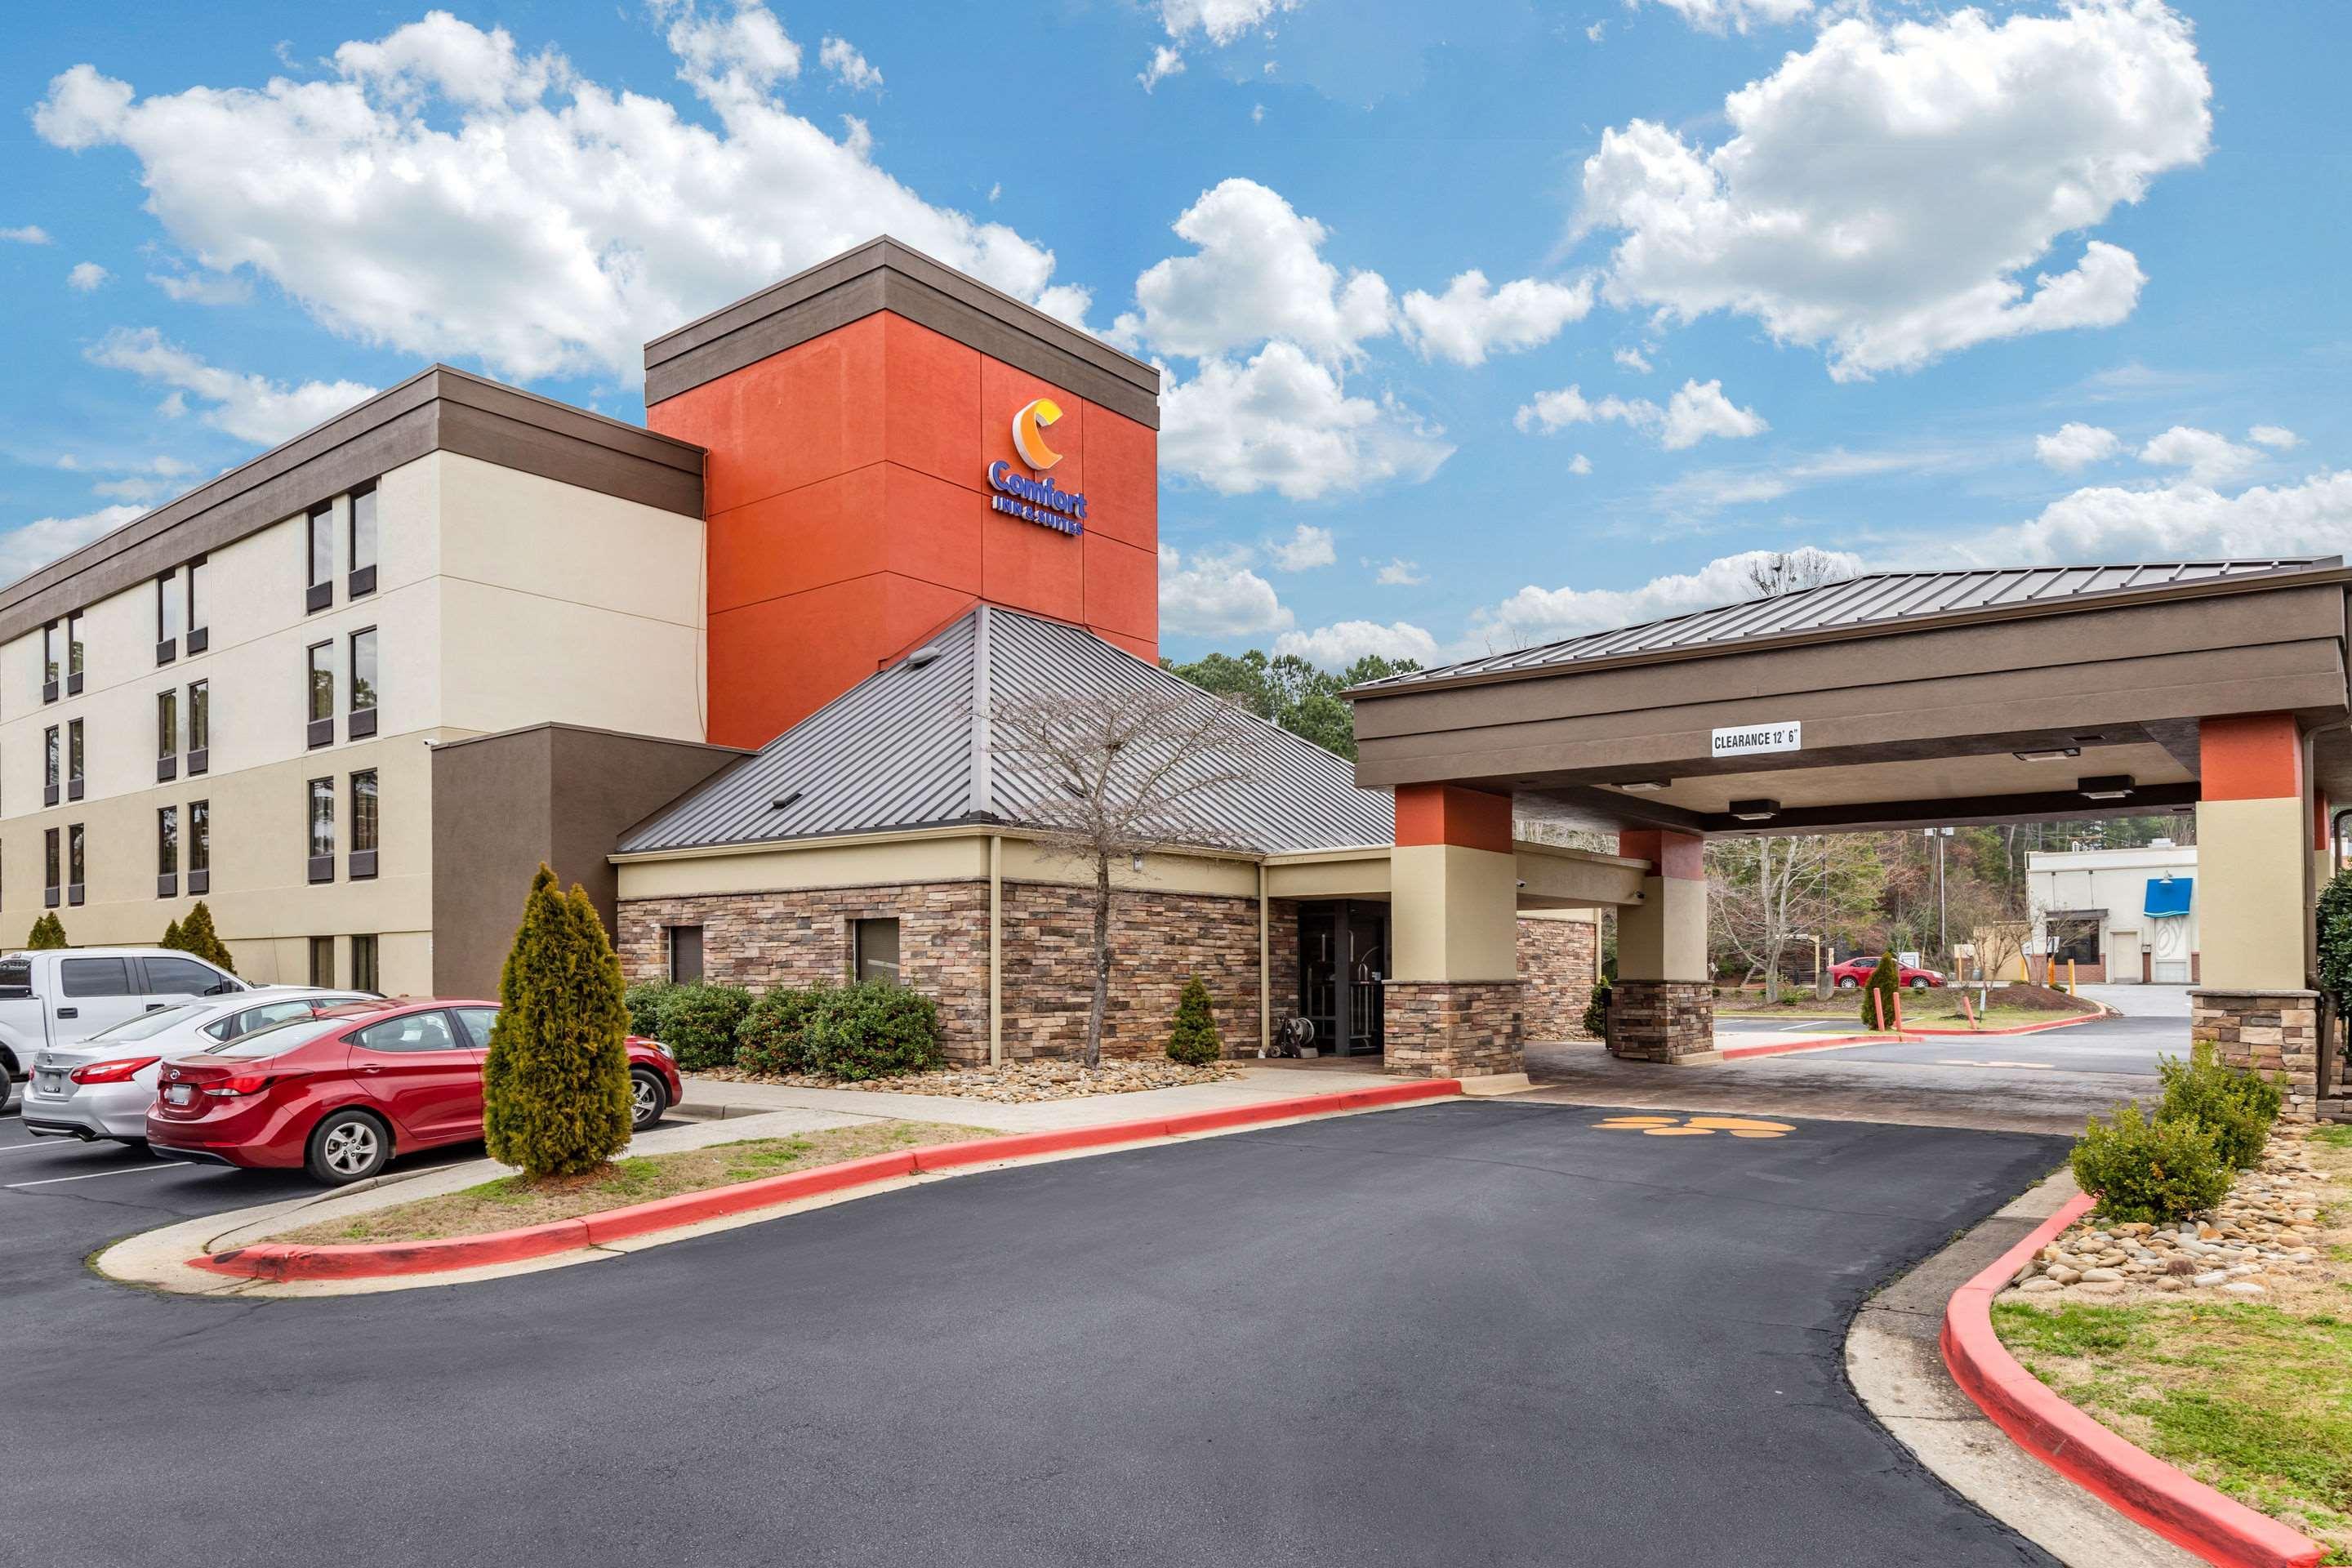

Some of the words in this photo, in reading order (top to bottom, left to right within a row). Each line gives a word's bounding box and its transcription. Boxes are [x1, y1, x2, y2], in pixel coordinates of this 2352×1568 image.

[989, 461, 1087, 519] Comfort
[993, 496, 1022, 516] INN
[1022, 506, 1034, 520] &
[1035, 510, 1083, 536] SUITES
[1715, 733, 1770, 749] CLEARANCE
